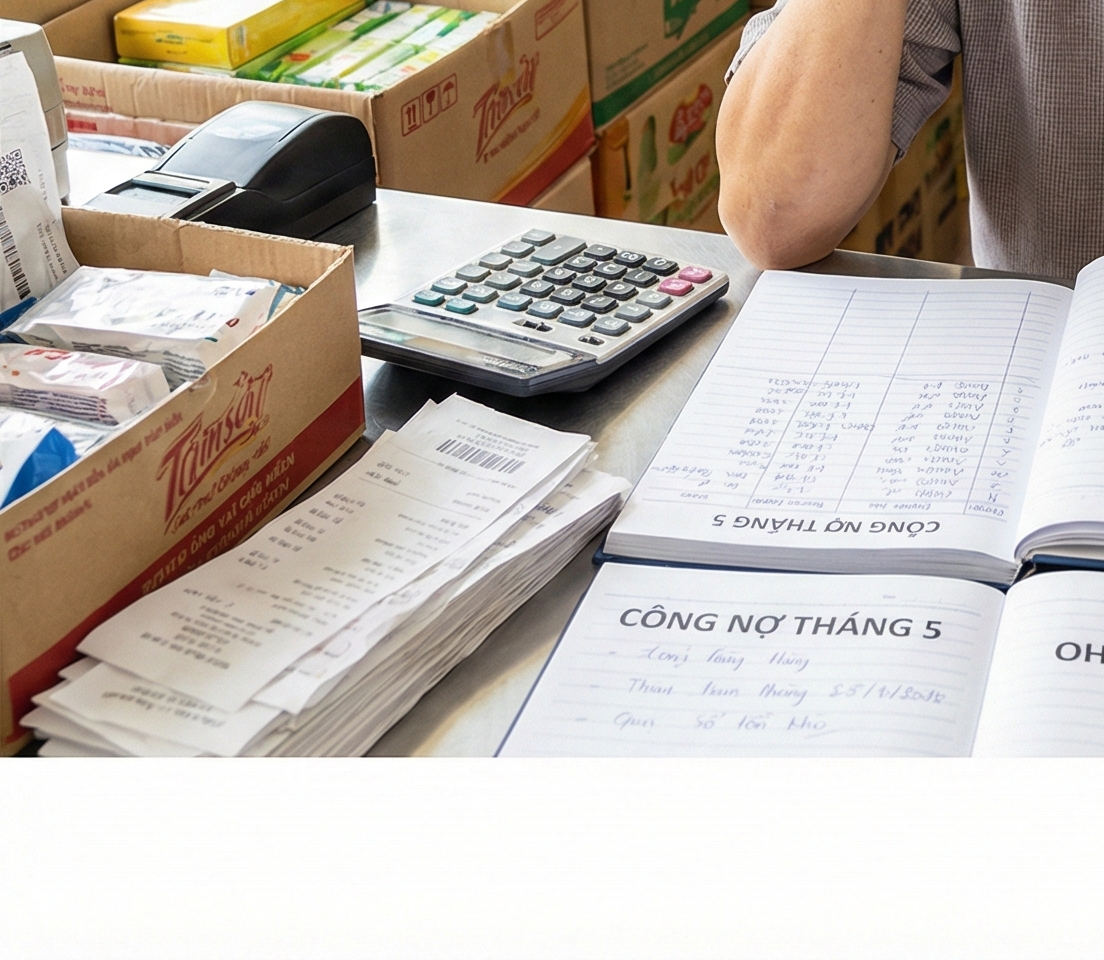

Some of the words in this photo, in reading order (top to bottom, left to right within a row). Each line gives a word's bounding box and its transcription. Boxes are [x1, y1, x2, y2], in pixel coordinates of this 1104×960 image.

[711, 513, 727, 528] 5
[618, 604, 719, 633] CÔNG
[726, 613, 788, 640] NỢ
[794, 611, 914, 639] THÁNG
[922, 619, 943, 640] 5
